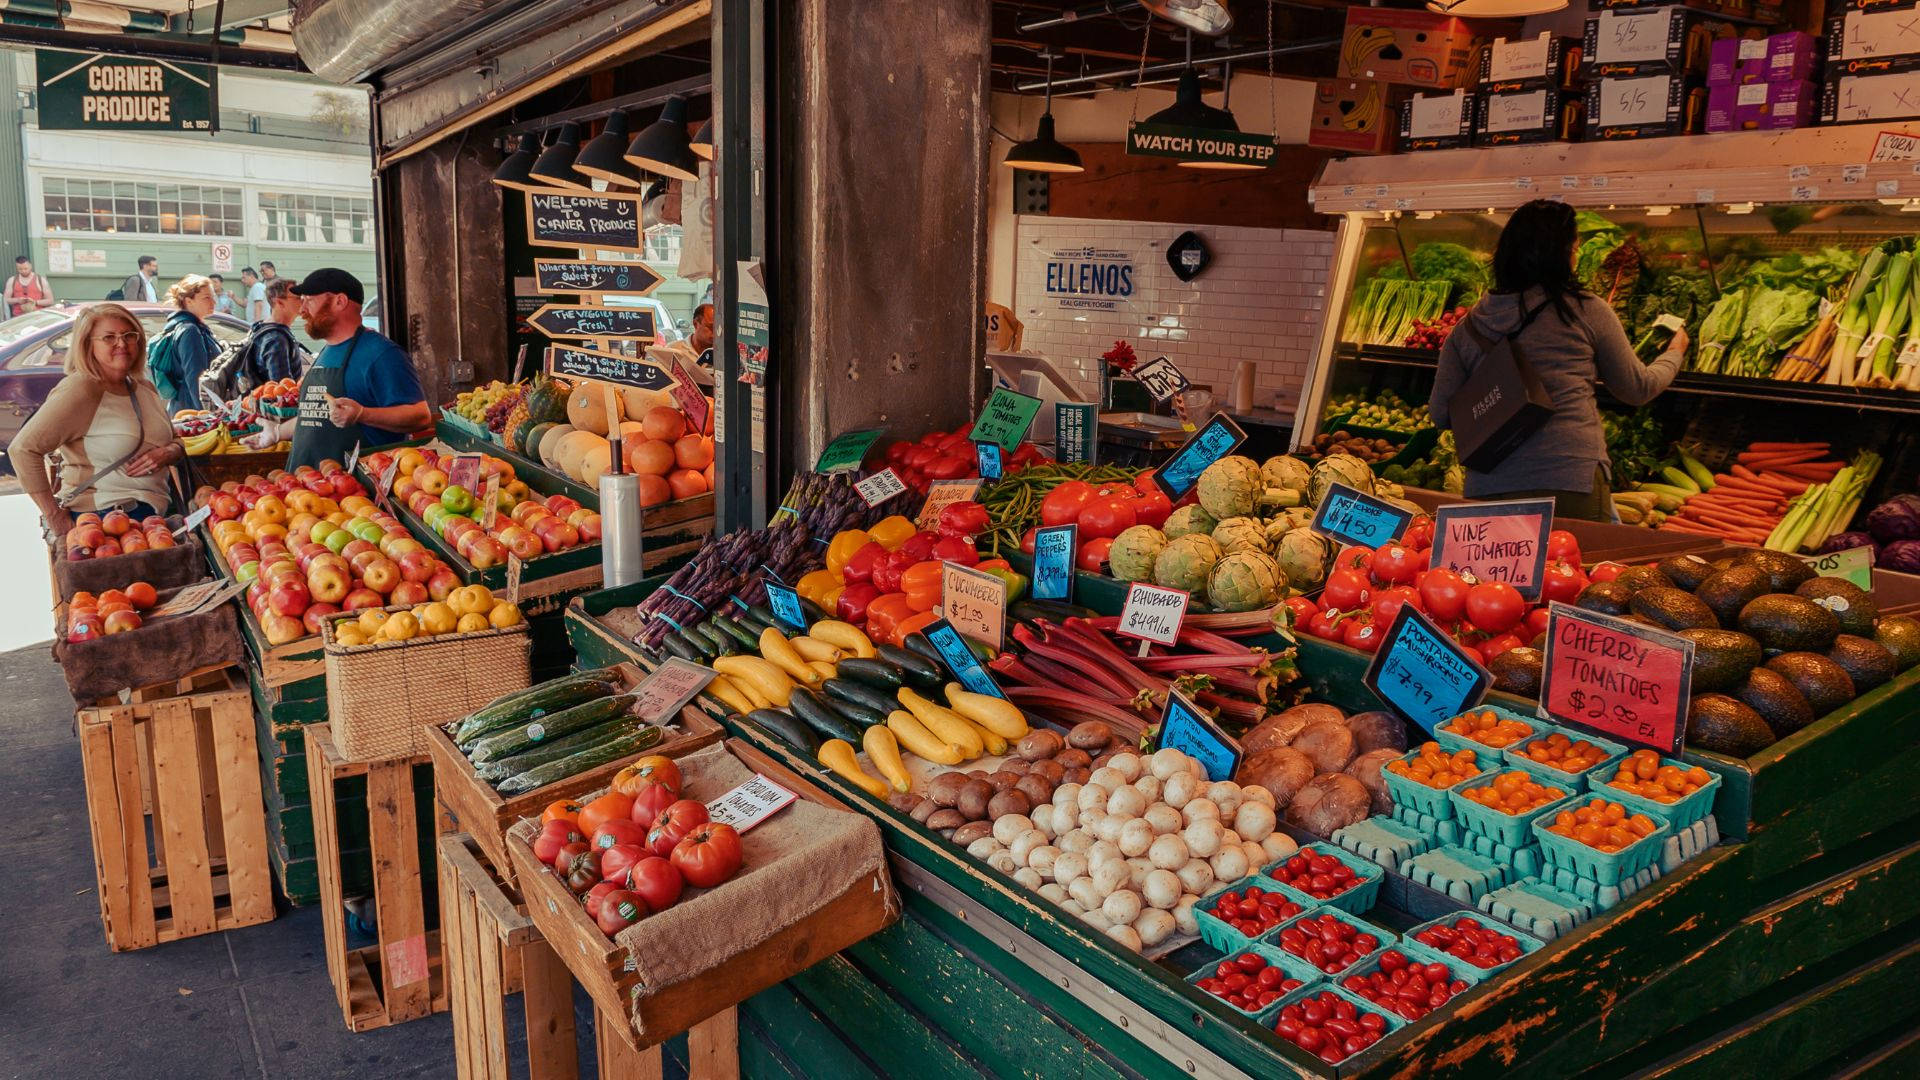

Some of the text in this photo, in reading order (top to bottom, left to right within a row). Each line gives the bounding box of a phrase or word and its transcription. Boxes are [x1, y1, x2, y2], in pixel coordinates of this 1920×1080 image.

[88, 65, 163, 92] CORNER
[82, 95, 171, 122] PRODUCE
[1134, 133, 1274, 160] WATCH YOUR STEP
[533, 195, 609, 210] WELCOME
[536, 217, 636, 233] CORNER PRODUCE
[1046, 262, 1133, 297] ELLENOS
[552, 310, 575, 320] THE
[991, 393, 1016, 412] ROMA
[1042, 533, 1065, 544] GREEN
[1452, 521, 1492, 542] VINE
[1461, 540, 1533, 561] TOMATOES
[948, 571, 1001, 605] CUCUMBERS
[1132, 588, 1182, 608] RHUBARB
[1406, 620, 1473, 681] PORTABELLO
[1561, 622, 1650, 668] CHERRY
[1398, 635, 1460, 686] MUSHROOMS
[1565, 656, 1661, 705] TOMATOES
[1174, 707, 1200, 735] BUTTON
